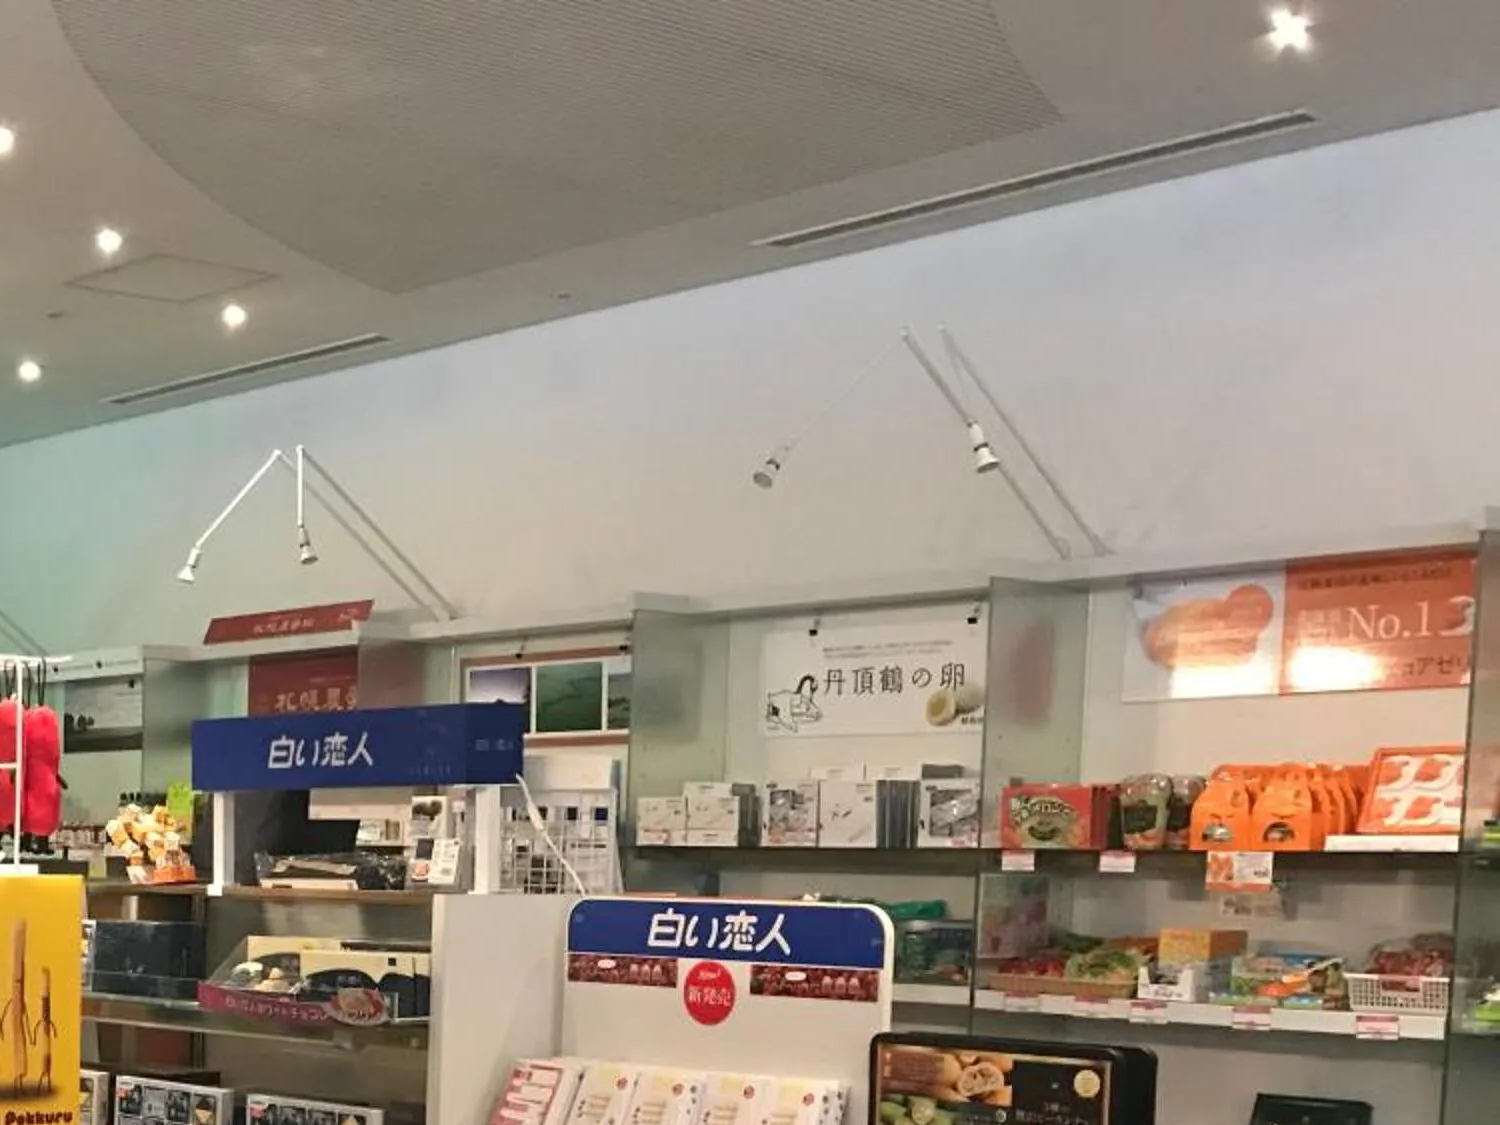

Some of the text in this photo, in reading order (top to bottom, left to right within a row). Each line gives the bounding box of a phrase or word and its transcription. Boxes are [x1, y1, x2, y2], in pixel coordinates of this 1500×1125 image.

[1348, 601, 1432, 640] No.1
[823, 662, 966, 696] 丹頂鶴の卵
[267, 731, 374, 769] 白い恋人
[647, 907, 792, 956] 白い恋人
